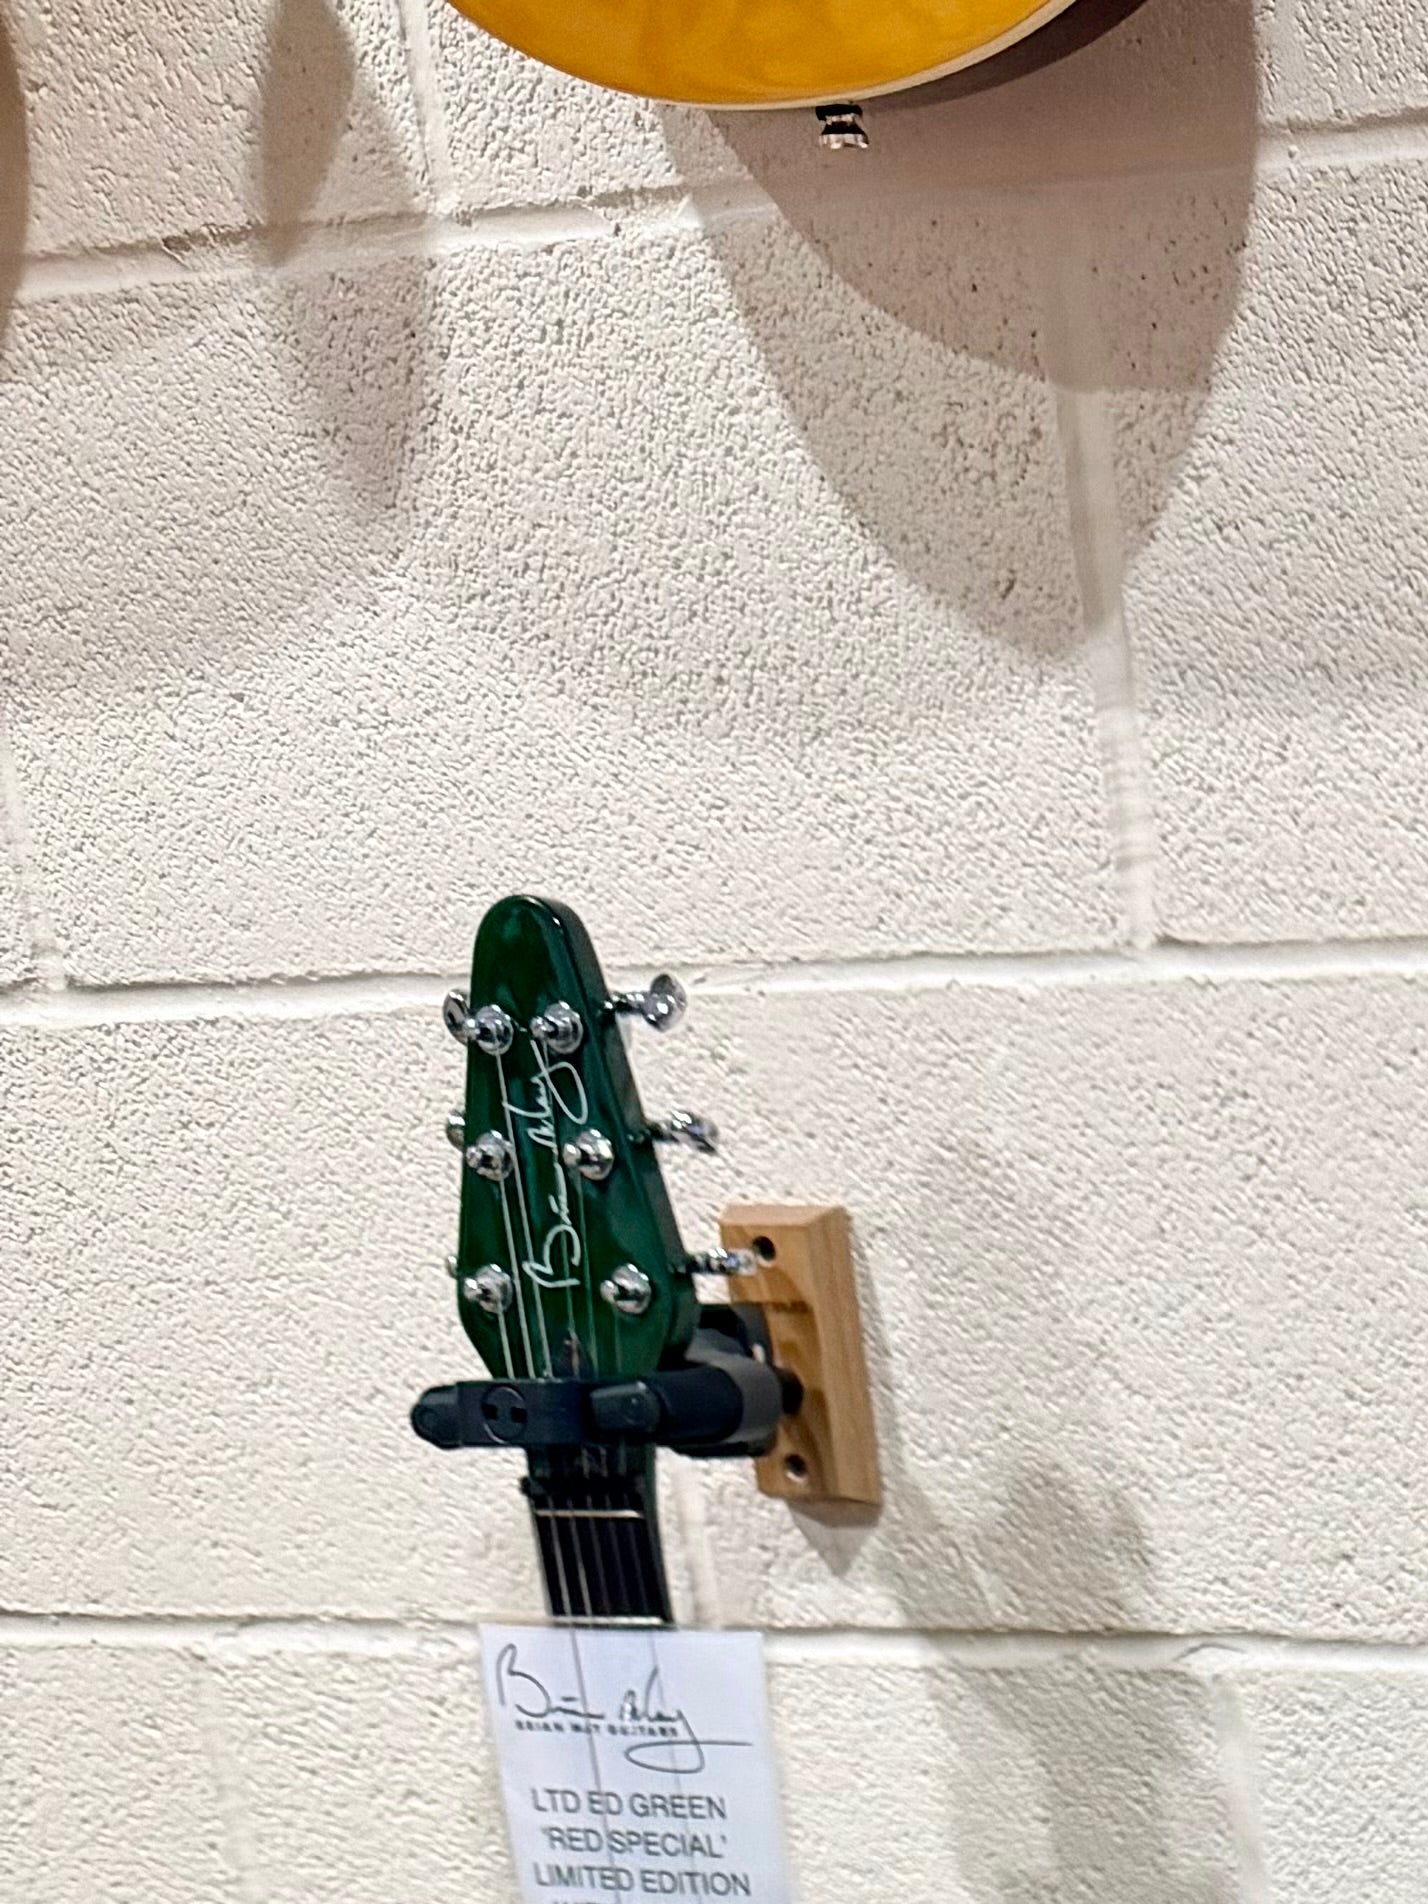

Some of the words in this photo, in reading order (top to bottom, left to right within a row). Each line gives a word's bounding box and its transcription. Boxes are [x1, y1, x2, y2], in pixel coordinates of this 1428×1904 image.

[531, 1788, 579, 1815] LTD
[588, 1790, 622, 1816] ED
[628, 1791, 727, 1820] GREEN
[534, 1862, 633, 1893] LIMITED
[642, 1867, 752, 1898] EDITION
